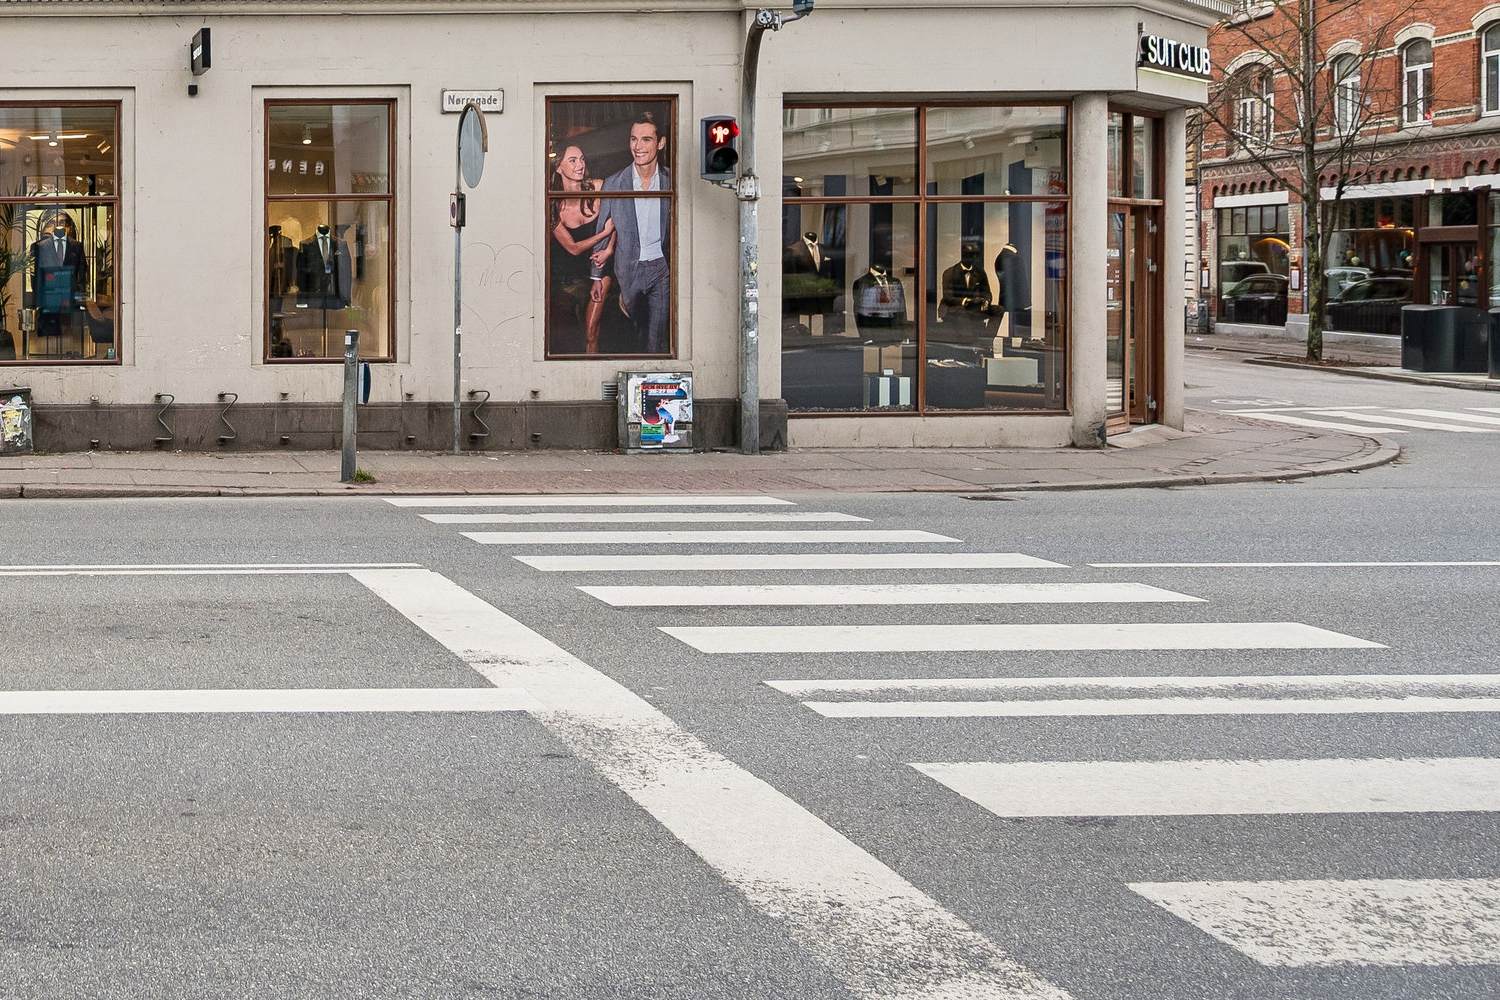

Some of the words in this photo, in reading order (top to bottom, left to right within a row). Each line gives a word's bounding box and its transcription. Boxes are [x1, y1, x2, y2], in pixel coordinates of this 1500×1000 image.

[1148, 34, 1176, 68] SUIT
[1178, 42, 1210, 75] CLUB
[448, 94, 498, 106] Nørregade
